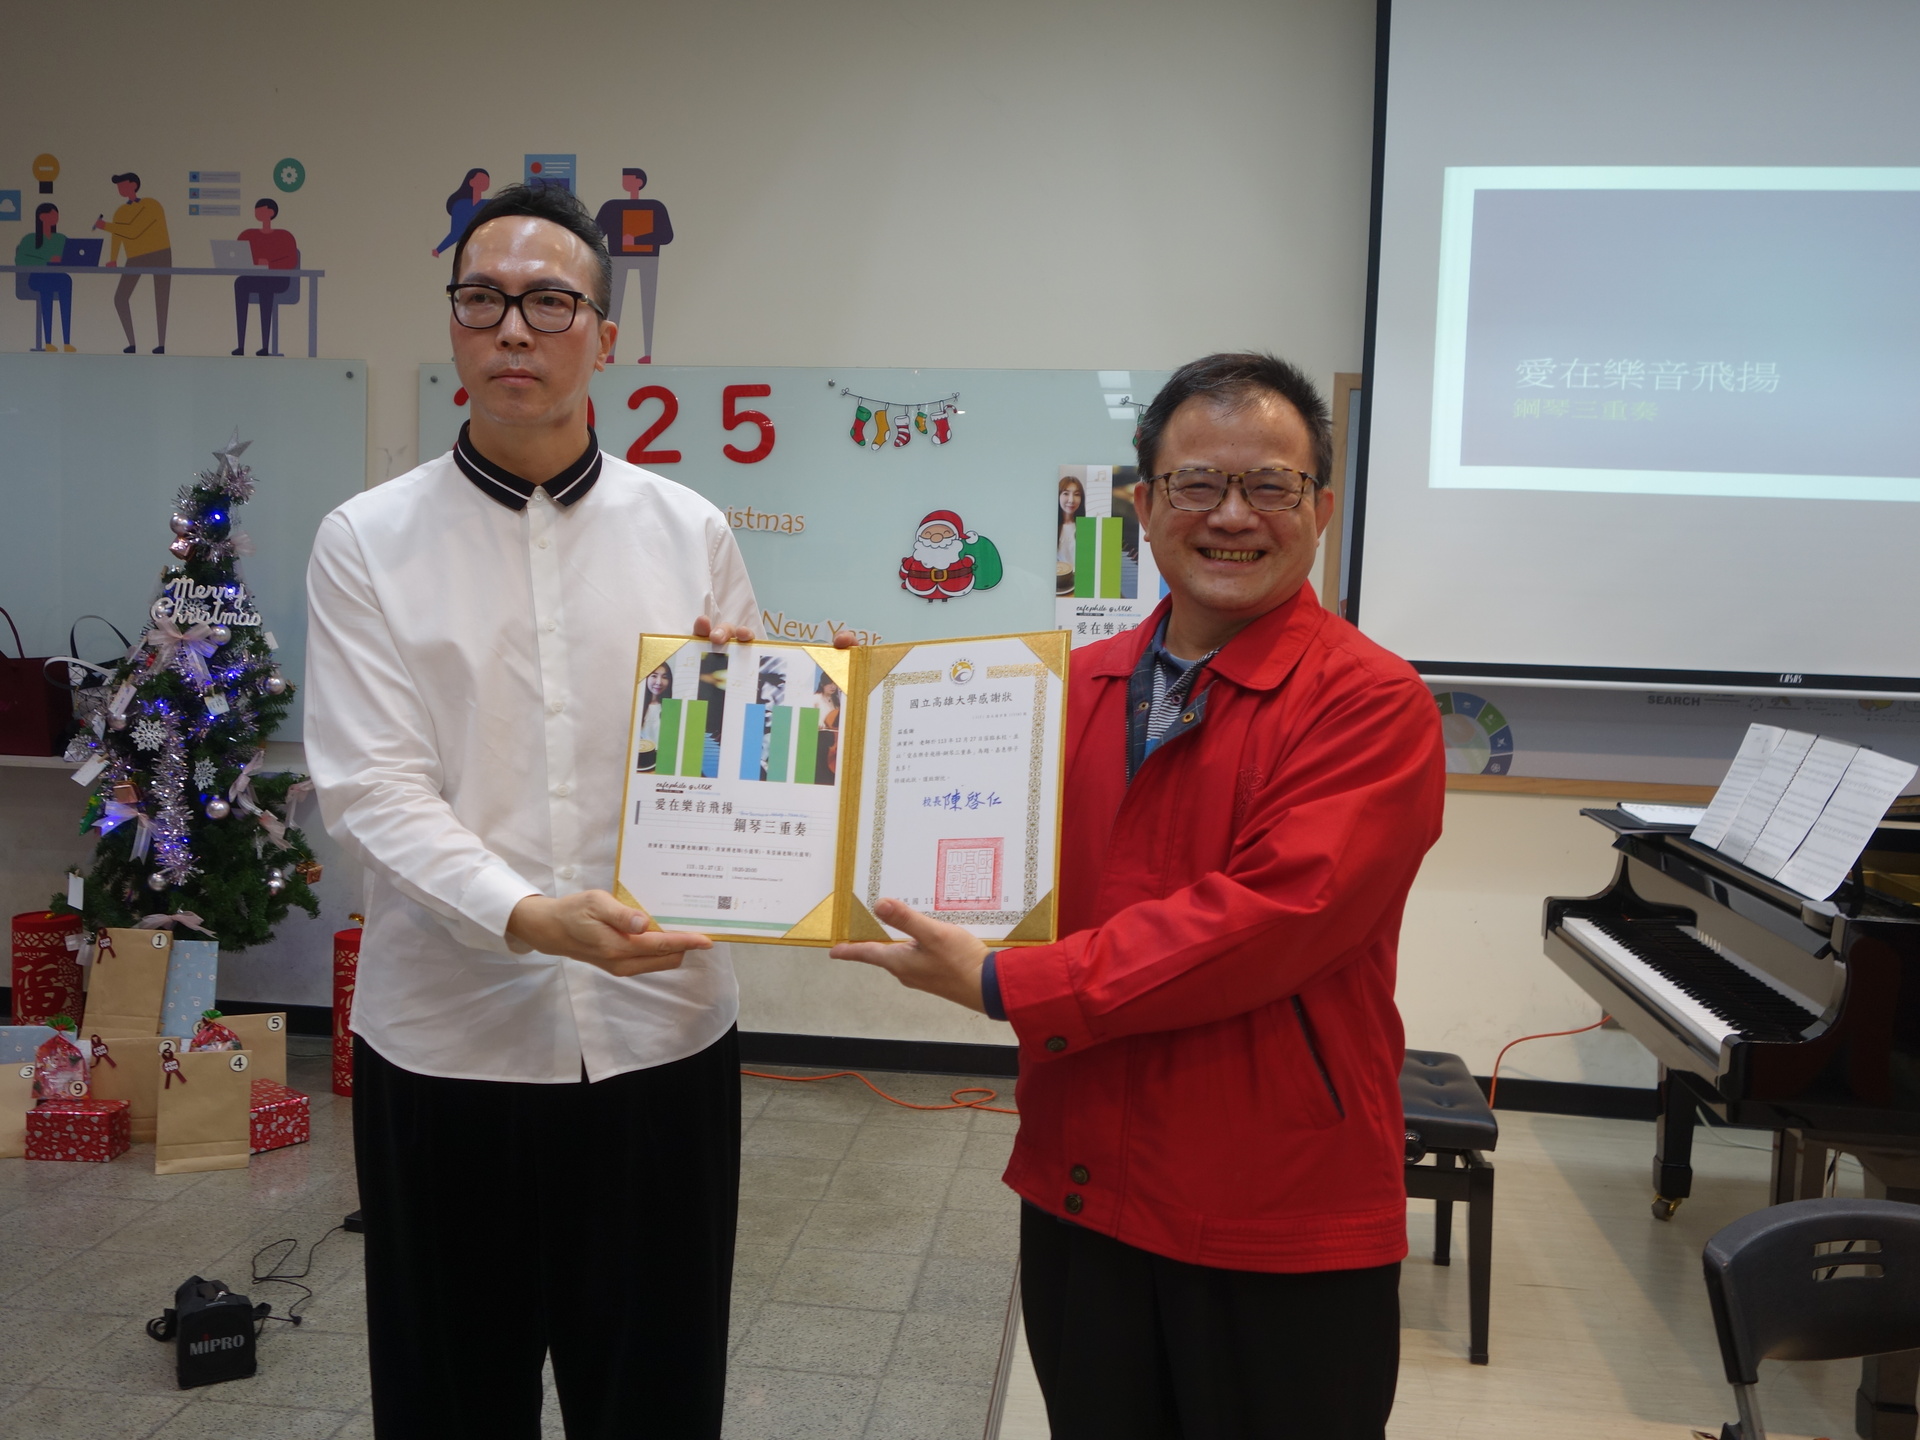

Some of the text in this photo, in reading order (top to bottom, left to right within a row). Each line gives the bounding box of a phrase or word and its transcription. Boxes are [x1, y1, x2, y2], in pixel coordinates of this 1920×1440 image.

[1515, 357, 1781, 394] 愛在樂音飛揚
[1513, 398, 1660, 422] 鋼琴三重奏
[725, 506, 805, 534] istmas
[165, 575, 246, 609] Merry
[150, 597, 262, 626] Christmas
[762, 610, 882, 646] New Yar
[909, 691, 1013, 709] 國立高雄大學感謝狀
[1647, 695, 1701, 706] SEARCH
[655, 798, 733, 815] 愛在樂音飛揚
[734, 818, 807, 837] 鋼琴三重奏
[155, 935, 163, 947] 1
[272, 1018, 279, 1029] 5
[234, 1056, 242, 1068] 4
[24, 1066, 33, 1077] 3
[74, 1083, 83, 1095] 9
